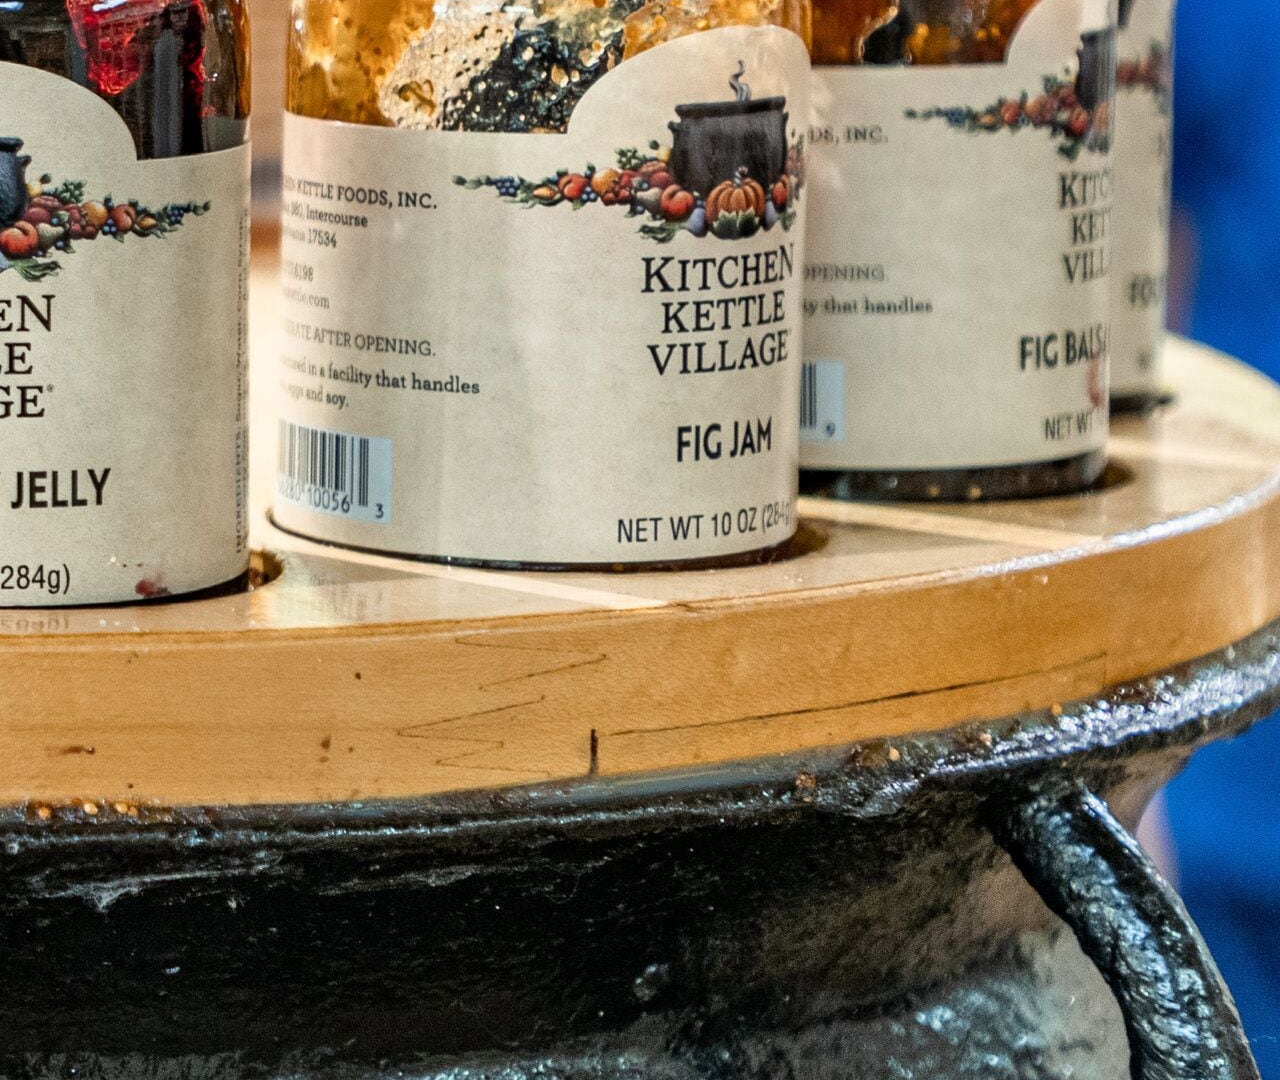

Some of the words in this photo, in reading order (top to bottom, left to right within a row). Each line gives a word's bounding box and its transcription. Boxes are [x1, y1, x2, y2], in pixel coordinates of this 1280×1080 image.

[297, 179, 334, 200] KETTLE
[337, 185, 392, 210] FOODS,
[398, 191, 437, 210] INC.
[306, 204, 368, 228] Intercourse
[308, 228, 337, 248] 17534
[640, 243, 794, 293] KITCHEN
[661, 290, 785, 334] KETTLE
[824, 294, 857, 316] that
[864, 293, 934, 316] handles
[313, 327, 351, 347] AFTER
[354, 333, 436, 357] OPENING.
[1019, 333, 1059, 370] FIG
[329, 361, 372, 388] facility
[376, 370, 406, 389] that
[411, 373, 480, 394] handles
[306, 384, 323, 402] and
[326, 392, 349, 410] soy.
[676, 422, 722, 463] FIG
[730, 416, 772, 458] JAM
[1044, 413, 1073, 441] NET
[11, 467, 112, 509] JELLY
[307, 485, 350, 513] 10056
[375, 503, 384, 519] 3
[617, 517, 663, 543] NET
[670, 514, 705, 541] WT
[711, 511, 732, 536] 10
[737, 507, 757, 534] OZ
